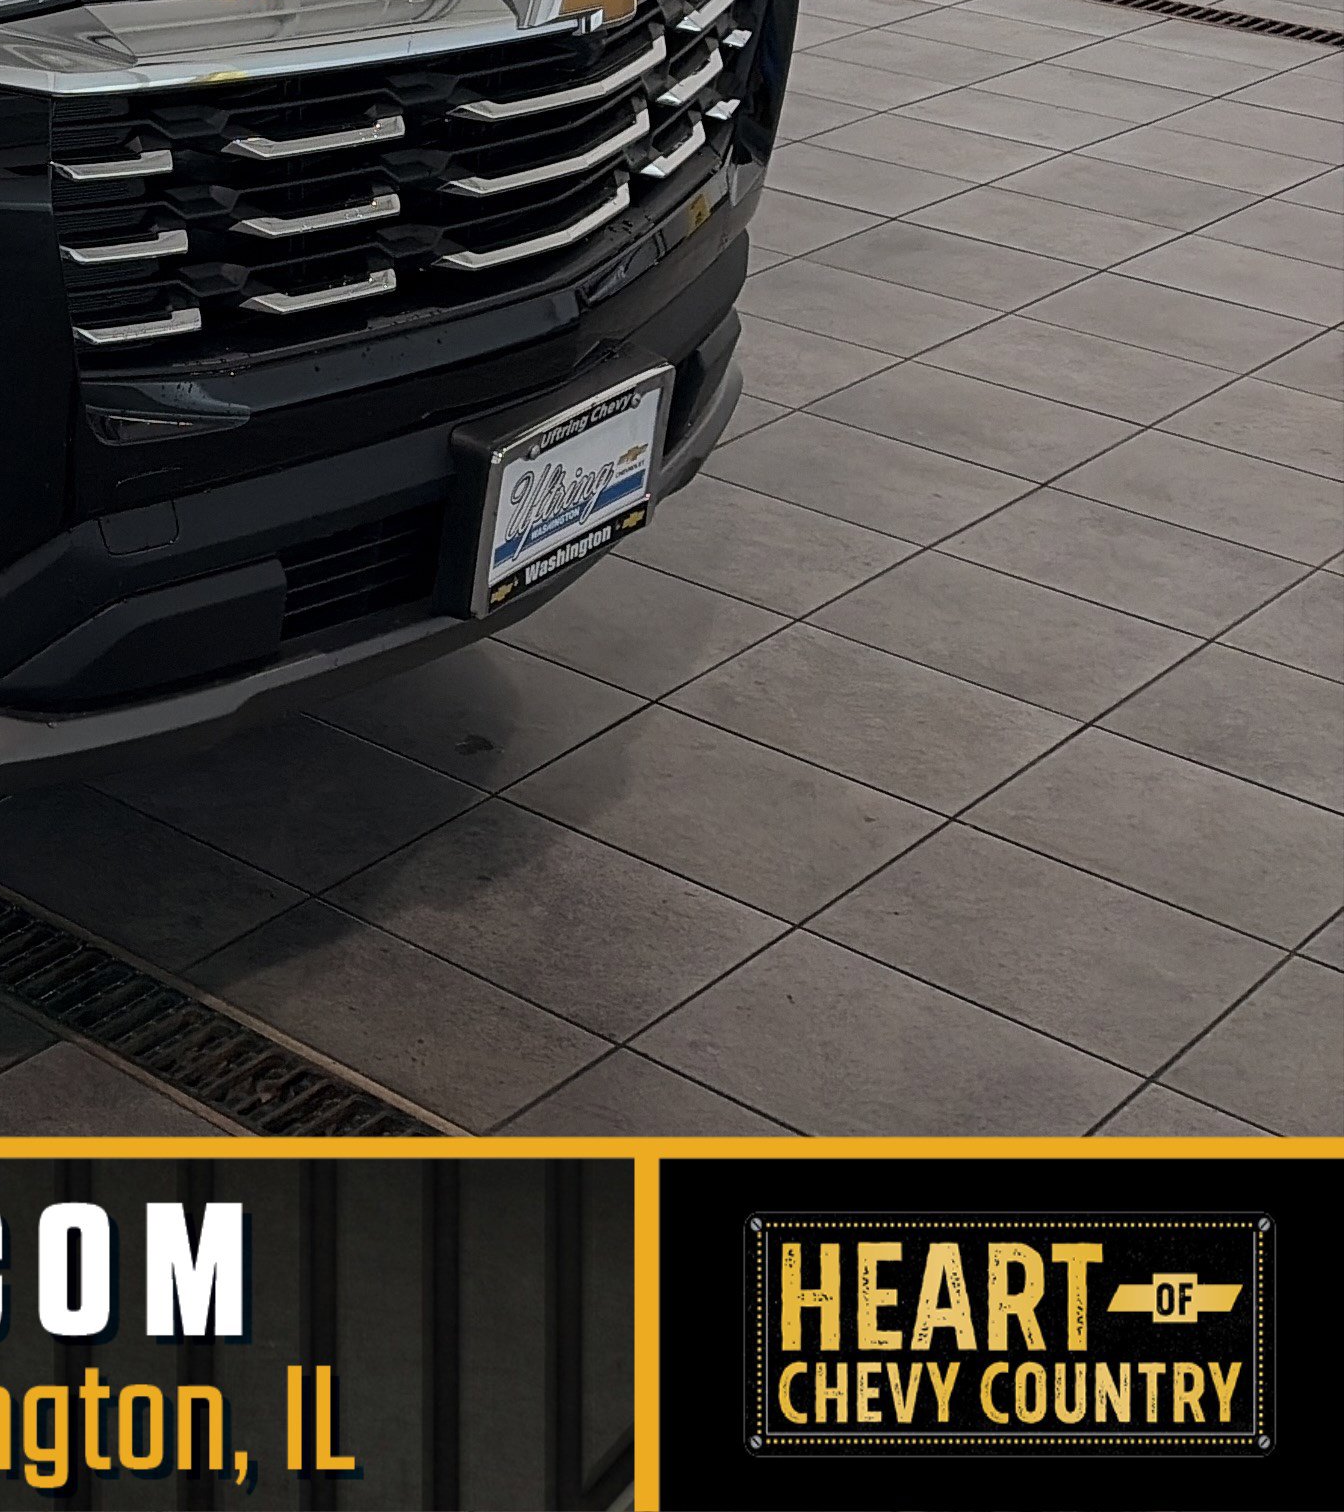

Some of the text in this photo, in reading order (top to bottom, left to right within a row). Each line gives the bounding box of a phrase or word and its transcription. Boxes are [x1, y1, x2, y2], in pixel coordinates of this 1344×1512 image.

[590, 395, 631, 423] Chevy
[505, 462, 614, 560] Uftring
[531, 507, 580, 541] WASHINGTON
[525, 527, 612, 586] Washington
